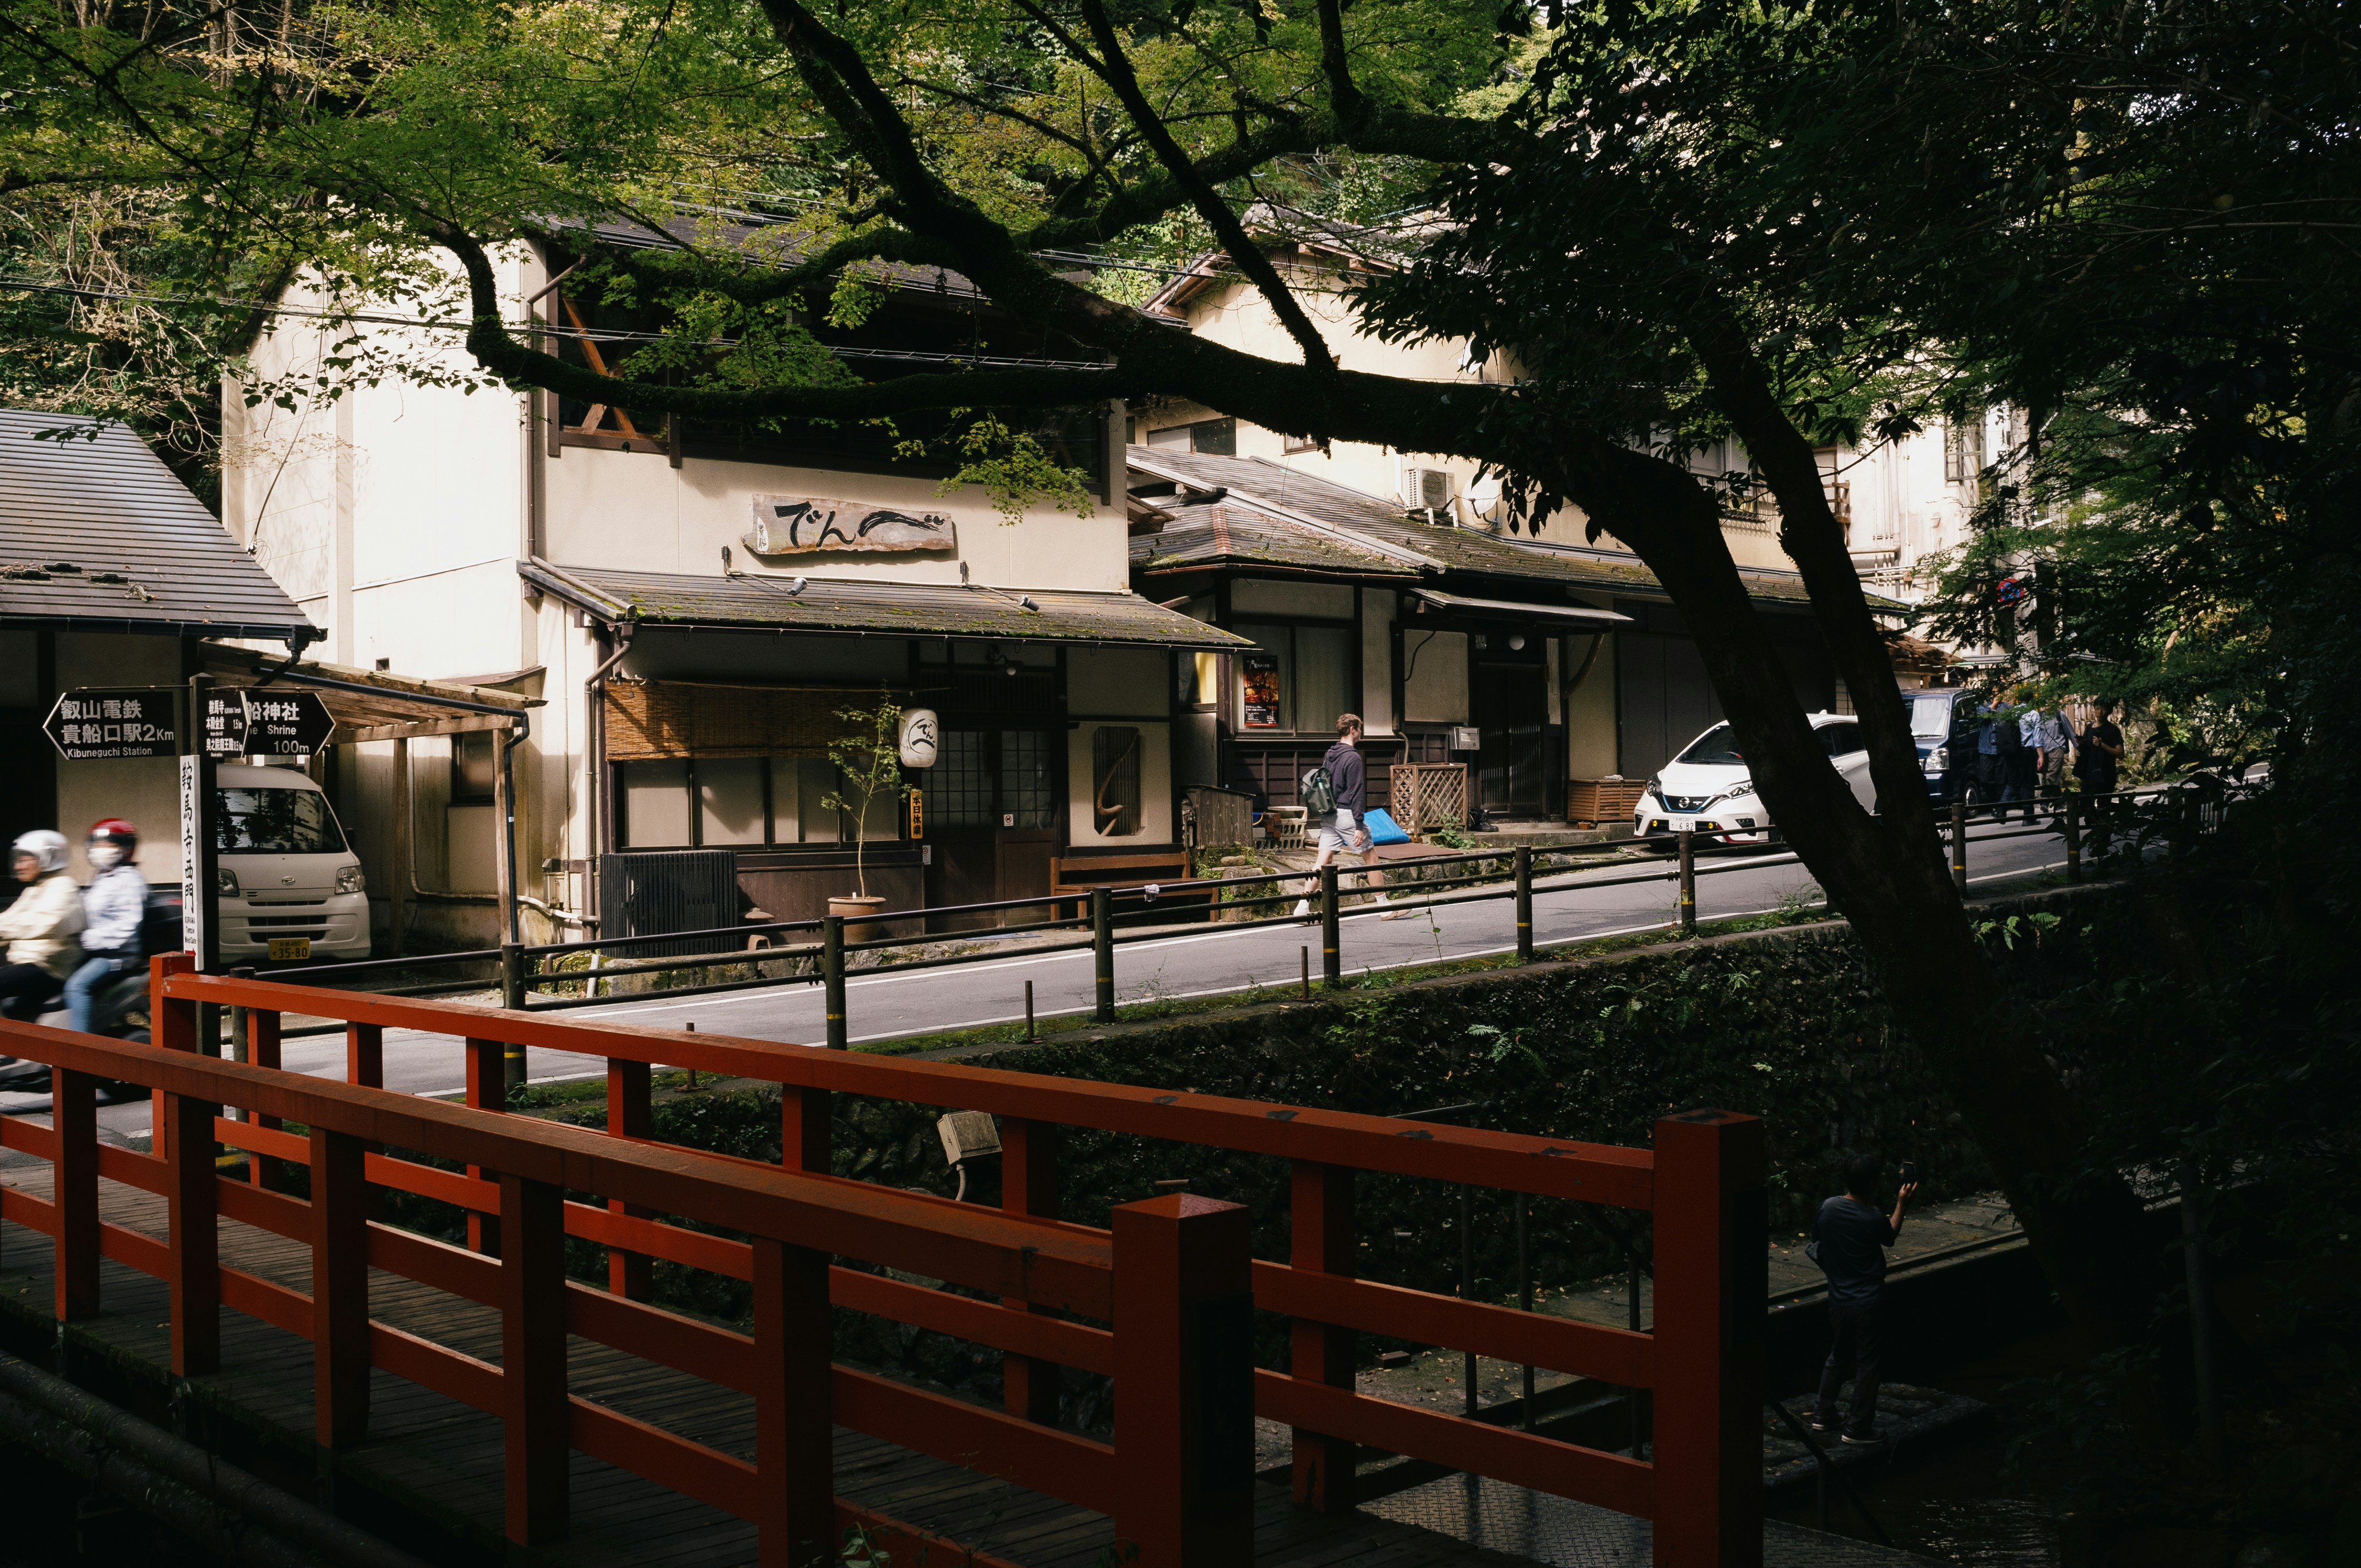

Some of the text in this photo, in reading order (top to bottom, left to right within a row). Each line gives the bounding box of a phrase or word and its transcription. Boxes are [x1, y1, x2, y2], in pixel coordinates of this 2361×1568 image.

[61, 699, 142, 720] 叡山電鉄
[267, 724, 297, 735] Shrine
[68, 747, 152, 758] Kibuneguchi Station
[274, 741, 309, 754] 100m
[278, 947, 308, 959] 35-80
